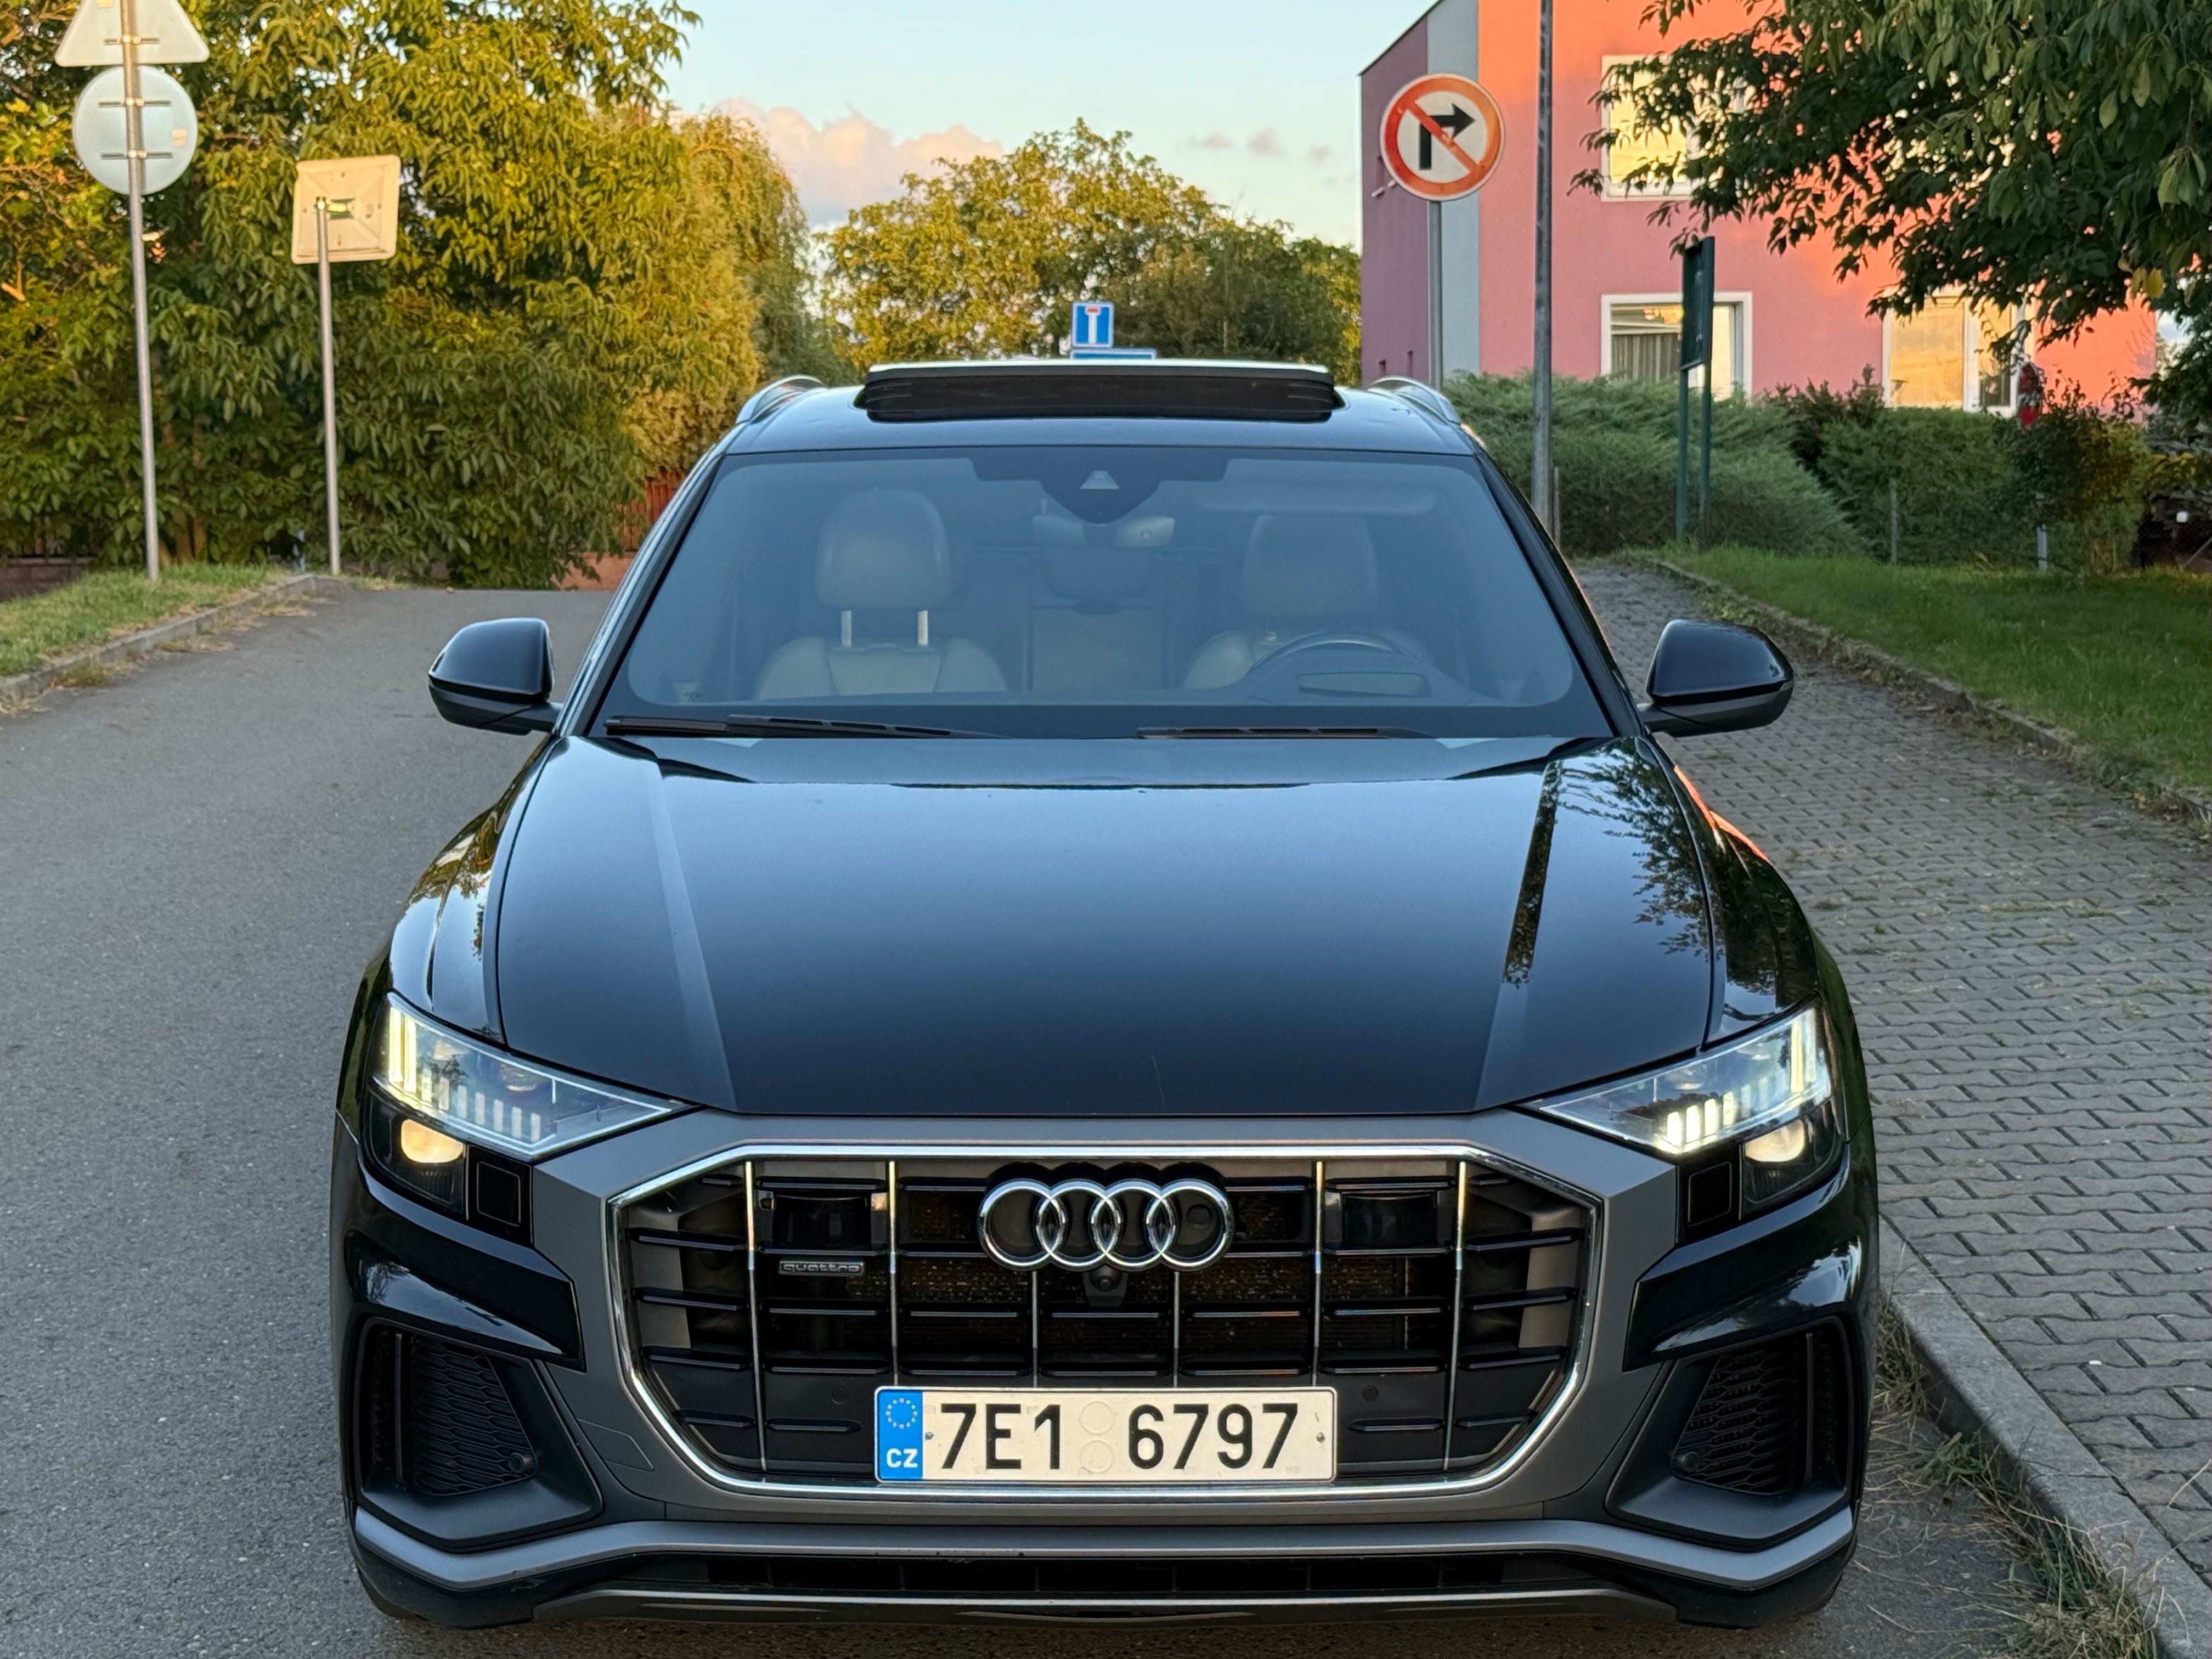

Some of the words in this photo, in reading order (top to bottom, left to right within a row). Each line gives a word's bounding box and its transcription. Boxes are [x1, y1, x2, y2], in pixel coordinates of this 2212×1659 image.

[886, 1448, 918, 1468] CZ
[941, 1403, 1060, 1470] 7E1
[1128, 1403, 1298, 1470] 6797
